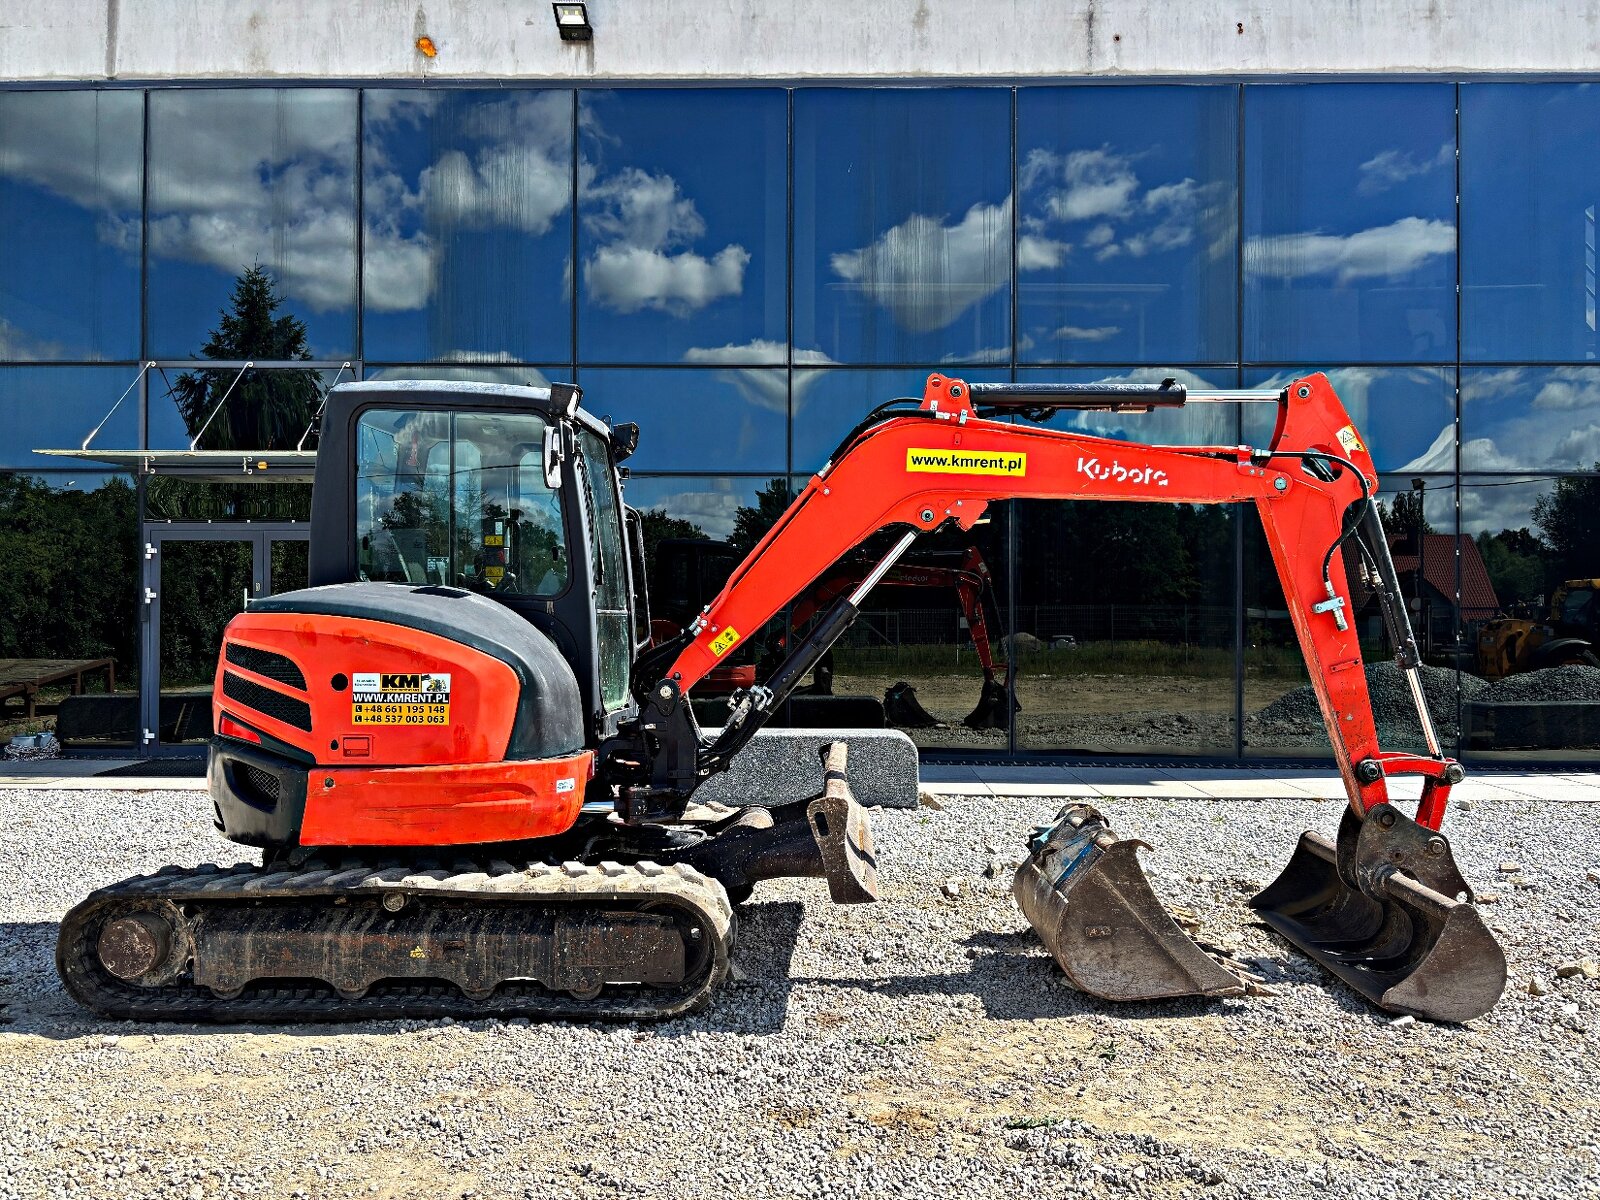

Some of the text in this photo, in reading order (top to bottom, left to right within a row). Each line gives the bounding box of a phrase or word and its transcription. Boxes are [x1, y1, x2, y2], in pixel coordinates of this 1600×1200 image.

[911, 455, 1022, 472] www.kmrent.pl
[1076, 457, 1168, 486] Kubota
[381, 675, 420, 688] KM
[353, 693, 449, 703] WWW.KMRENT.PL
[364, 705, 445, 713] +48 661 195 148
[364, 715, 445, 723] +48 537 003 063
